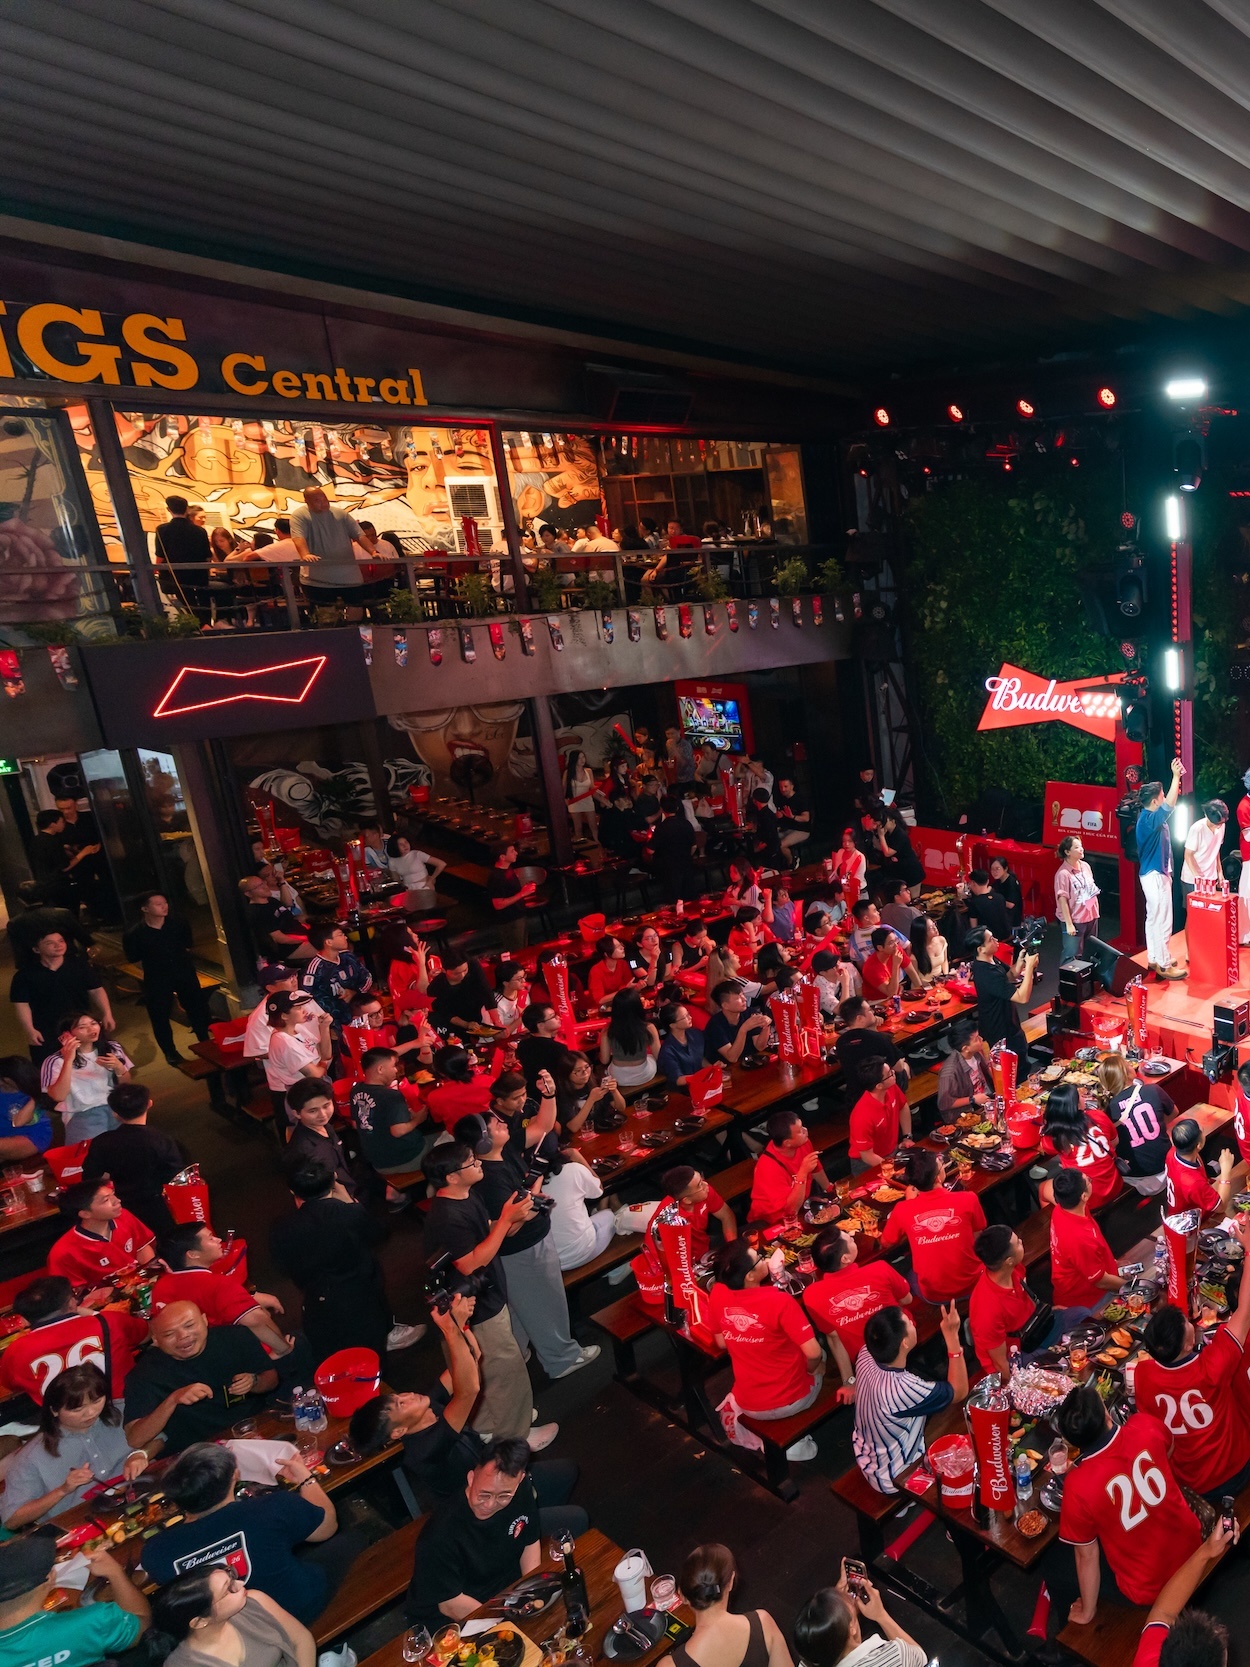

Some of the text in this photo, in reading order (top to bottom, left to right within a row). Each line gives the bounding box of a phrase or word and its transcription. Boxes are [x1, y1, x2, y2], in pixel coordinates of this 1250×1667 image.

[0, 303, 429, 407] GS Central
[985, 677, 1085, 713] Budwe
[1227, 899, 1240, 986] Budweiser
[783, 1009, 795, 1057] Budweiser
[1120, 1102, 1161, 1148] 10
[191, 1196, 206, 1222] eiser
[914, 1232, 960, 1245] Budweiser
[677, 1235, 694, 1300] Budweiser
[722, 1330, 765, 1344] Budweiser
[836, 1304, 883, 1326] Budweiser
[1155, 1389, 1214, 1435] 26
[987, 1423, 1009, 1501] Budweiser
[1105, 1450, 1167, 1531] 26
[182, 1541, 238, 1571] Budweiser
[231, 1555, 241, 1564] 26
